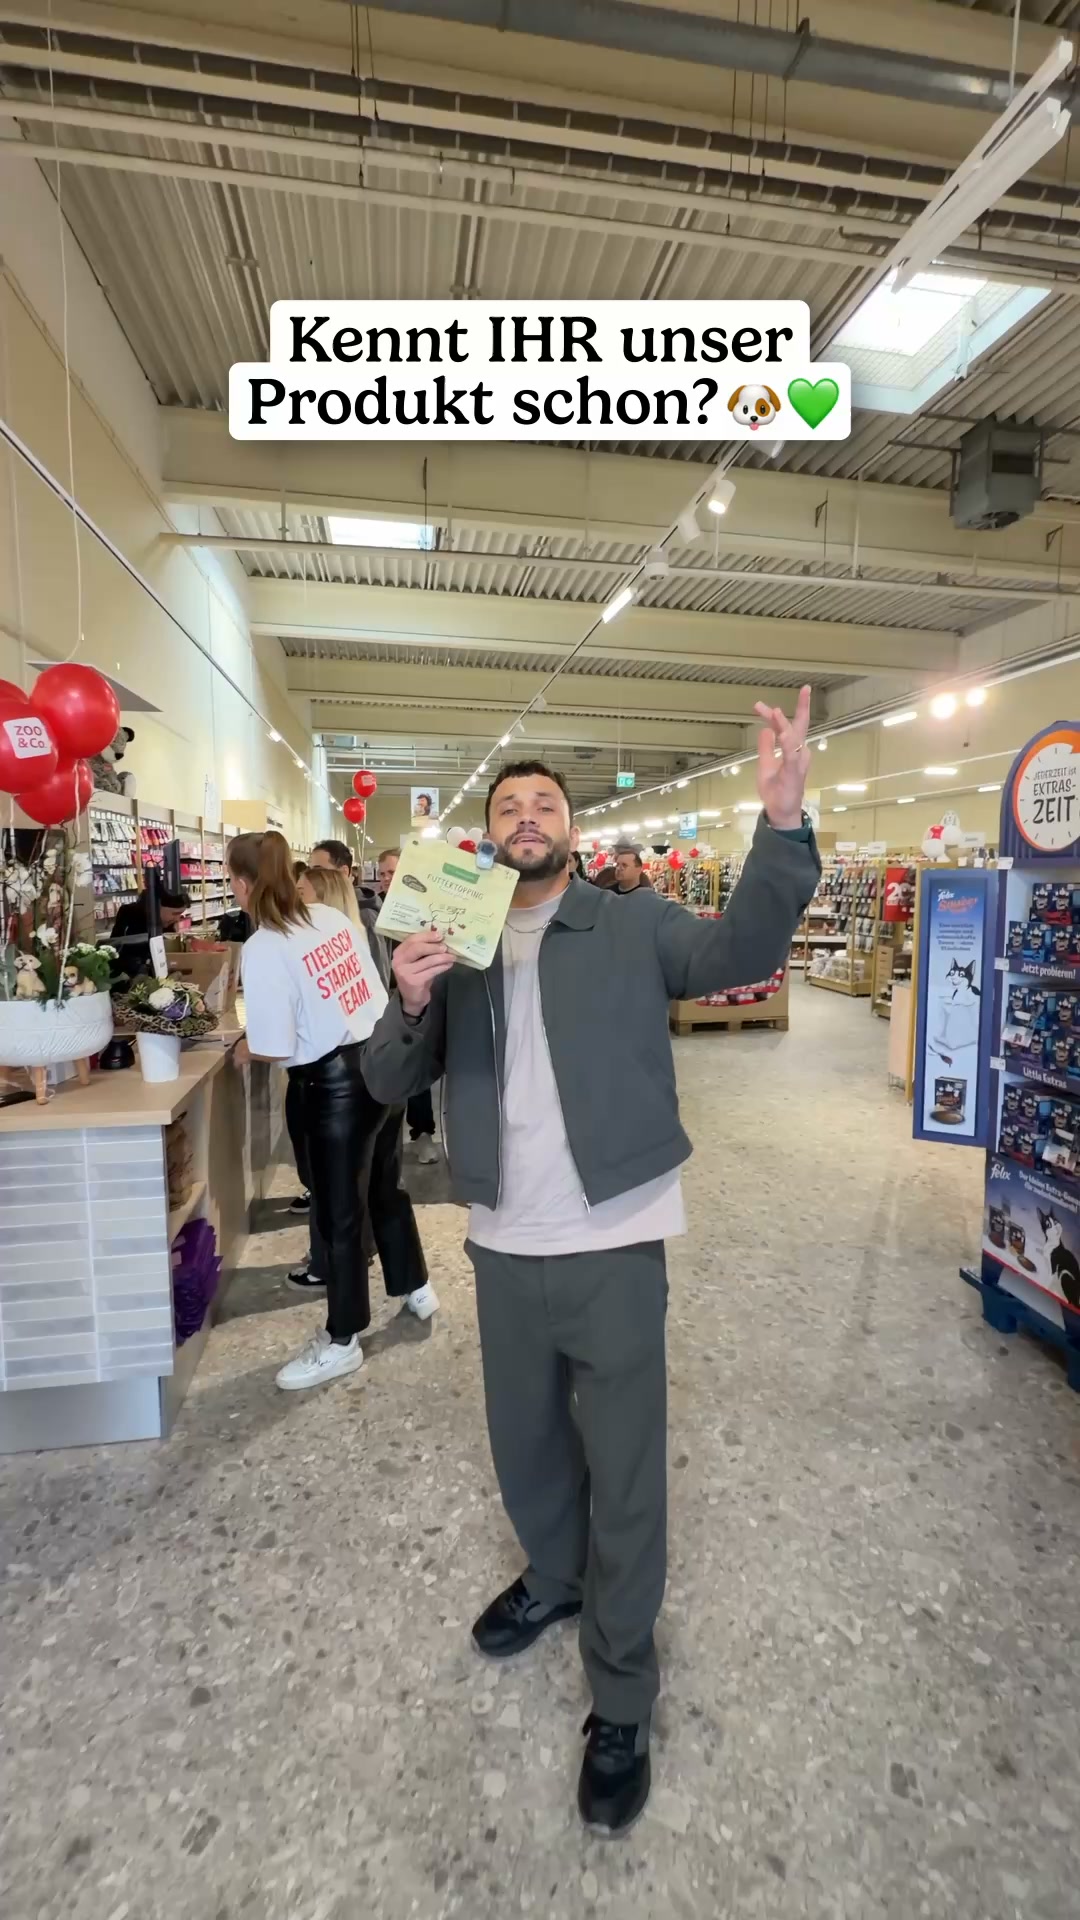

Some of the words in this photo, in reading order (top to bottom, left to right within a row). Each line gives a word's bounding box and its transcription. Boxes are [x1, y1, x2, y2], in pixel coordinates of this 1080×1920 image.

[14, 725, 42, 736] ZOO
[1033, 767, 1067, 780] JEDERZEIT
[1033, 778, 1076, 796] EXTRAS-
[1033, 795, 1075, 824] ZEIT
[1021, 962, 1039, 974] Jetzt
[1039, 965, 1076, 980] probieren!
[1042, 1072, 1067, 1089] Extras
[990, 1163, 1011, 1180] felix
